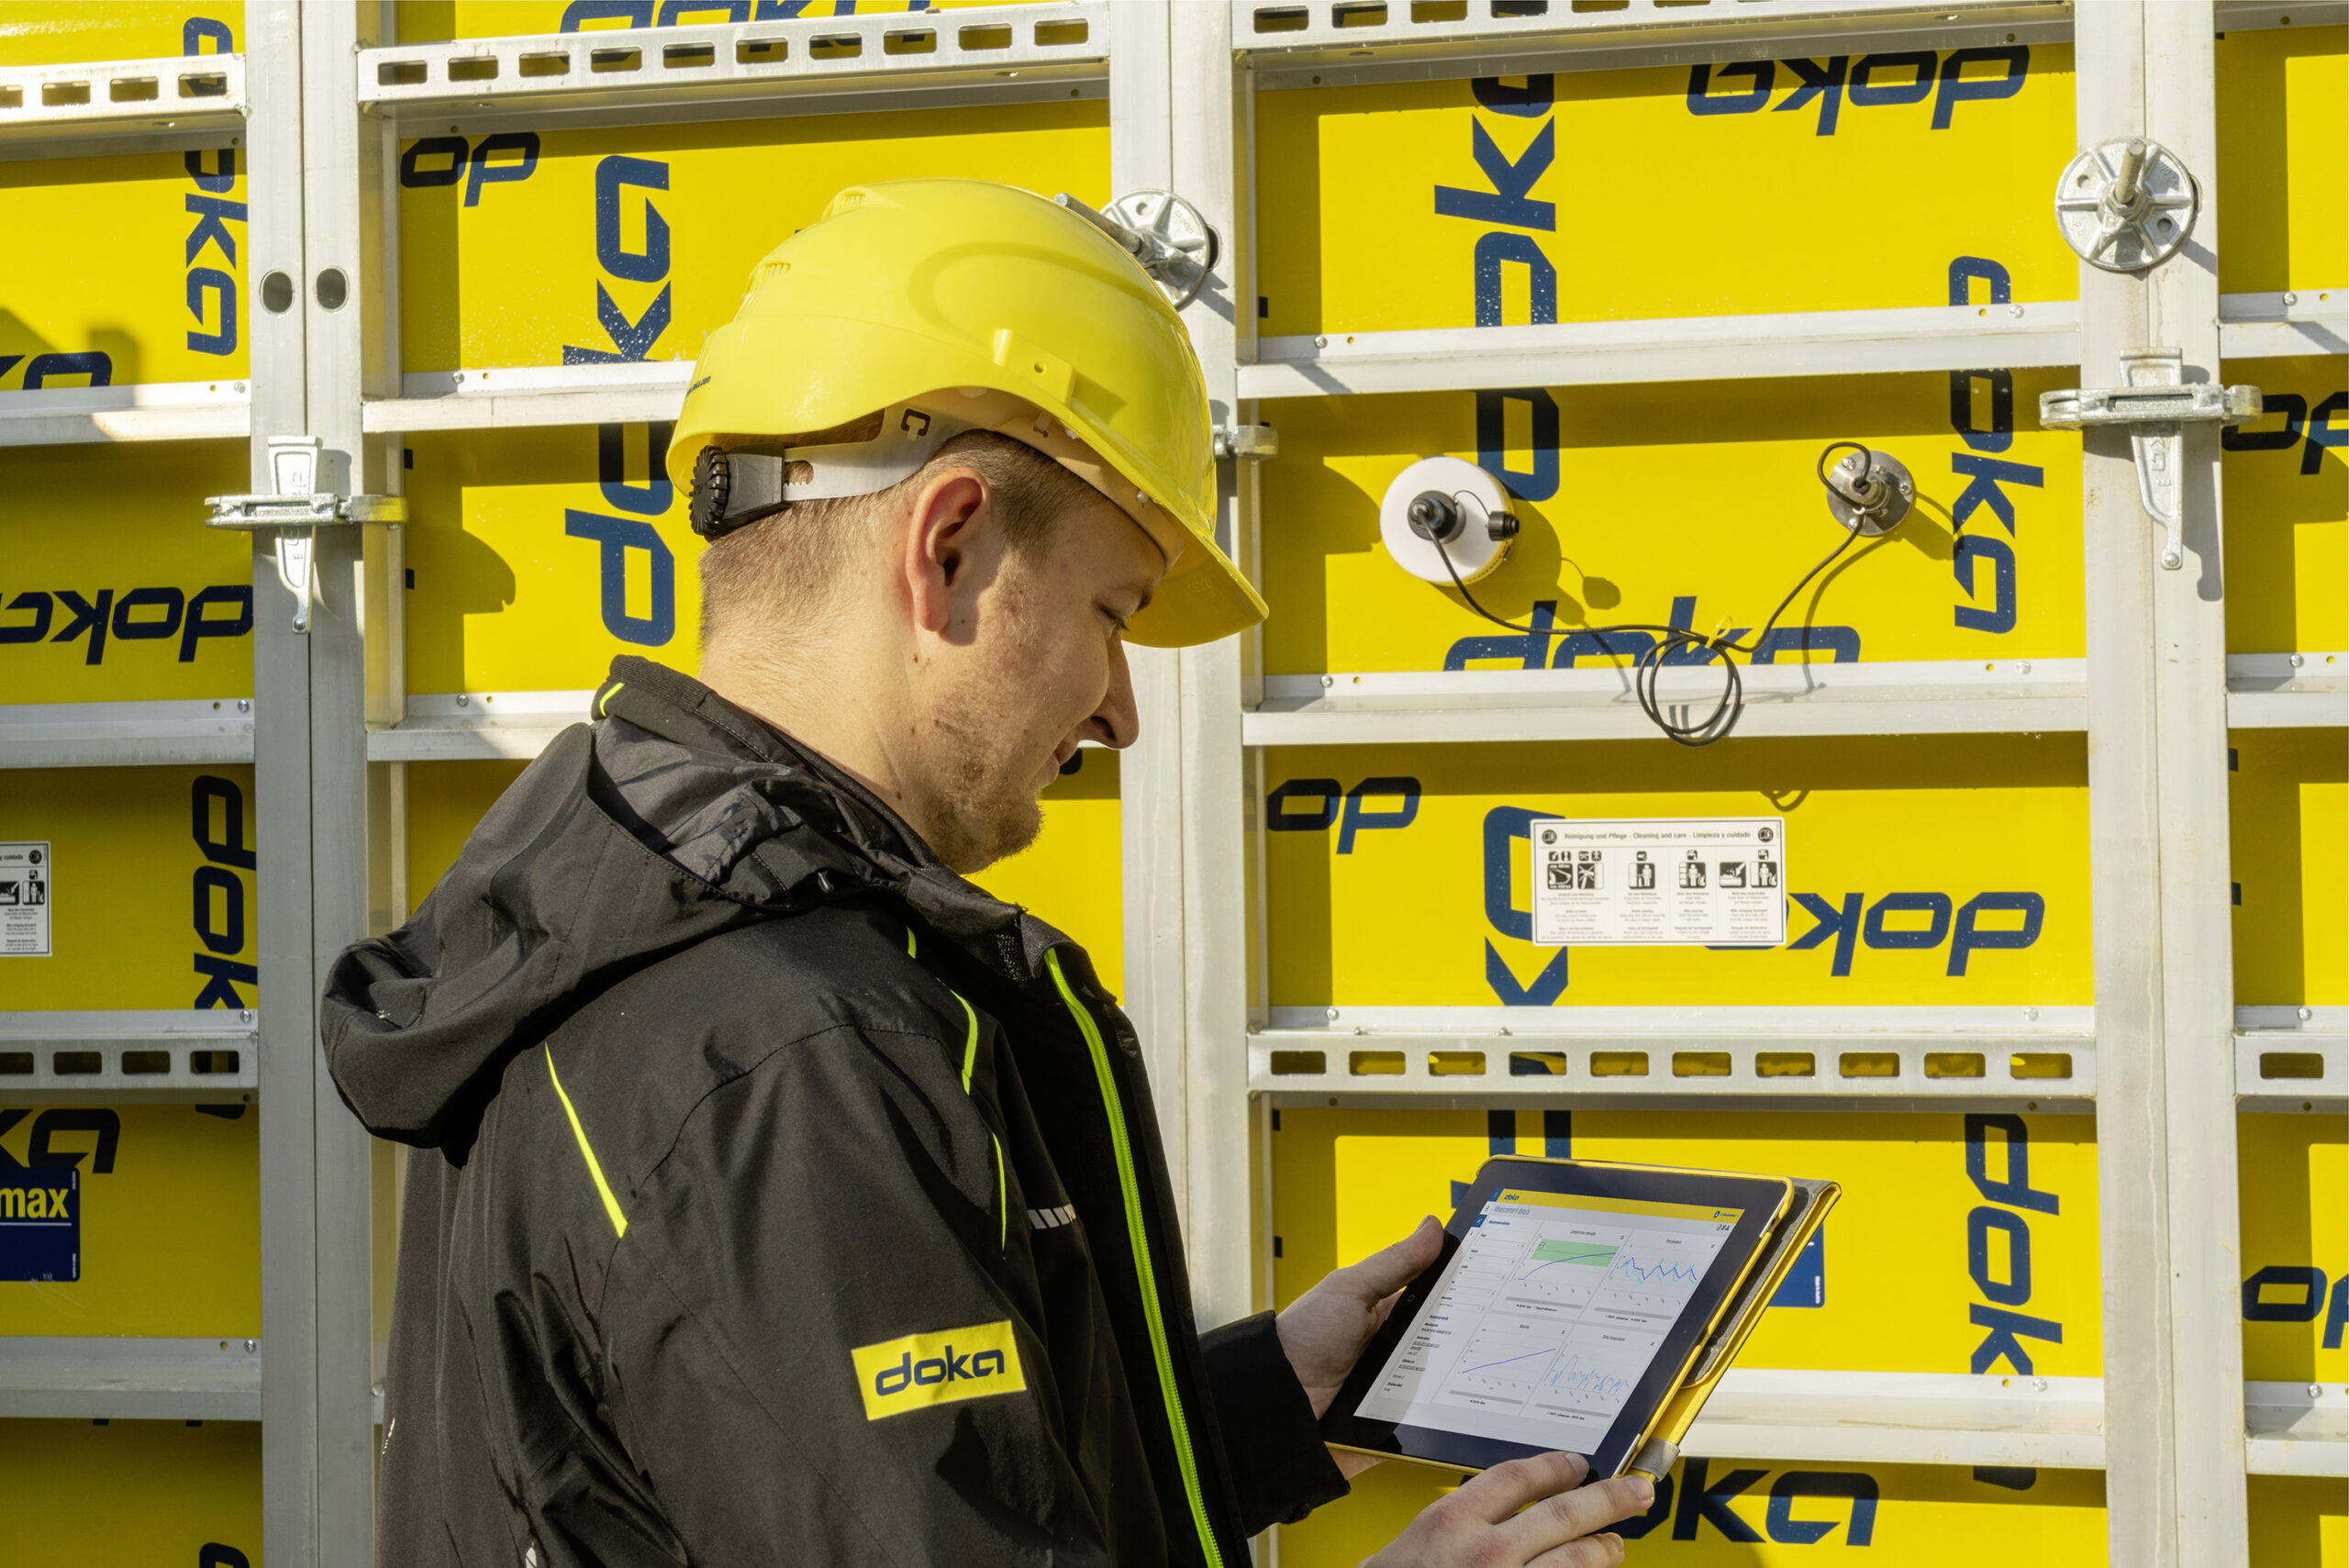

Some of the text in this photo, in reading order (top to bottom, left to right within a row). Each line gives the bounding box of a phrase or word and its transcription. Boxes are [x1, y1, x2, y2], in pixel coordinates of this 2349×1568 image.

[1687, 44, 2031, 136] doka
[1633, 831, 1659, 840] Cleaning
[1693, 830, 1720, 840] Limpieza
[1726, 830, 1751, 839] cuidado
[1707, 891, 2045, 976] dok
[0, 1187, 69, 1218] max
[875, 1344, 1005, 1396] doka
